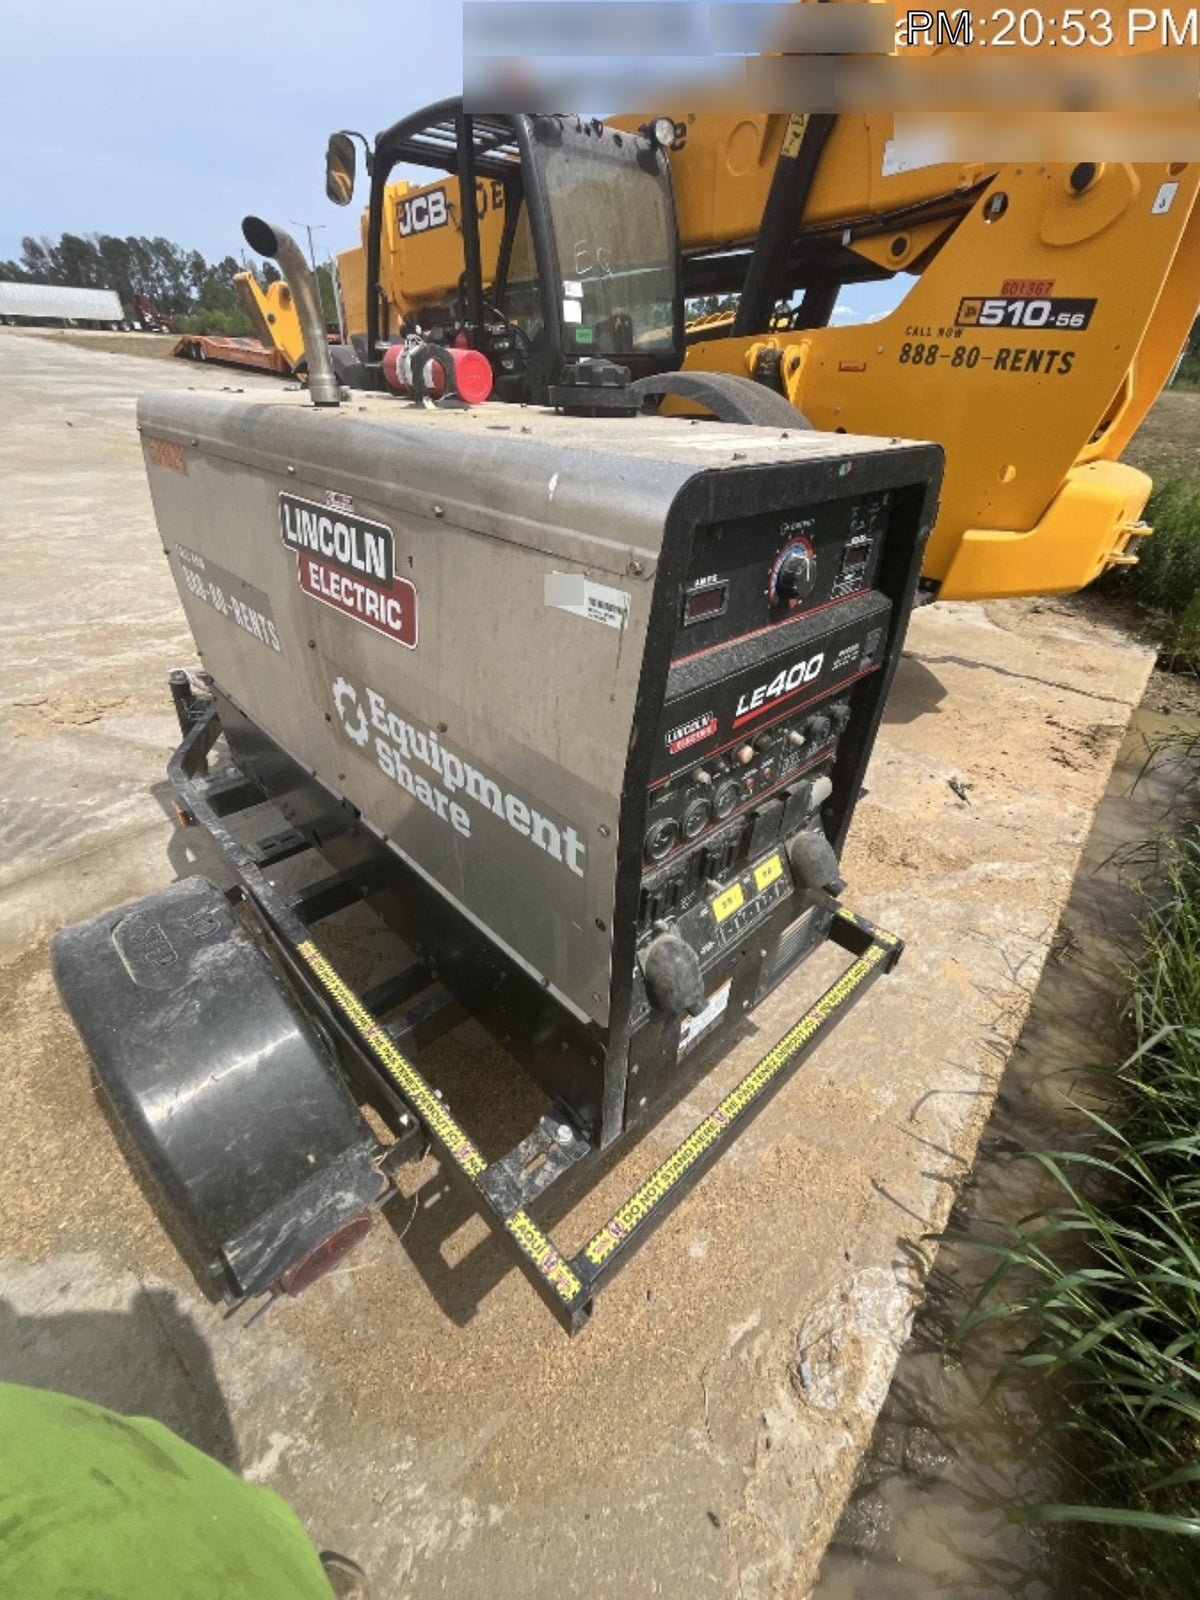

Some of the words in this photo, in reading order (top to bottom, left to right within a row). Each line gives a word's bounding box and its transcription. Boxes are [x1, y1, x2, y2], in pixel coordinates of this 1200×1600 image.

[400, 191, 448, 236] JCB
[980, 300, 1085, 327] 510-56
[1001, 282, 1053, 296] 601367
[898, 342, 1076, 375] 888-80-RENTS
[904, 326, 933, 337] CALL
[936, 326, 965, 339] NOW
[284, 503, 387, 580] LINCOLN
[308, 561, 403, 631] ELECTRIC
[736, 652, 825, 717] LE400
[366, 687, 586, 878] Equipment
[374, 737, 472, 839] Share
[620, 1202, 642, 1224] DO
[638, 1178, 664, 1206] NOT
[659, 1145, 695, 1183] STAND
[690, 1120, 718, 1150] HERE
